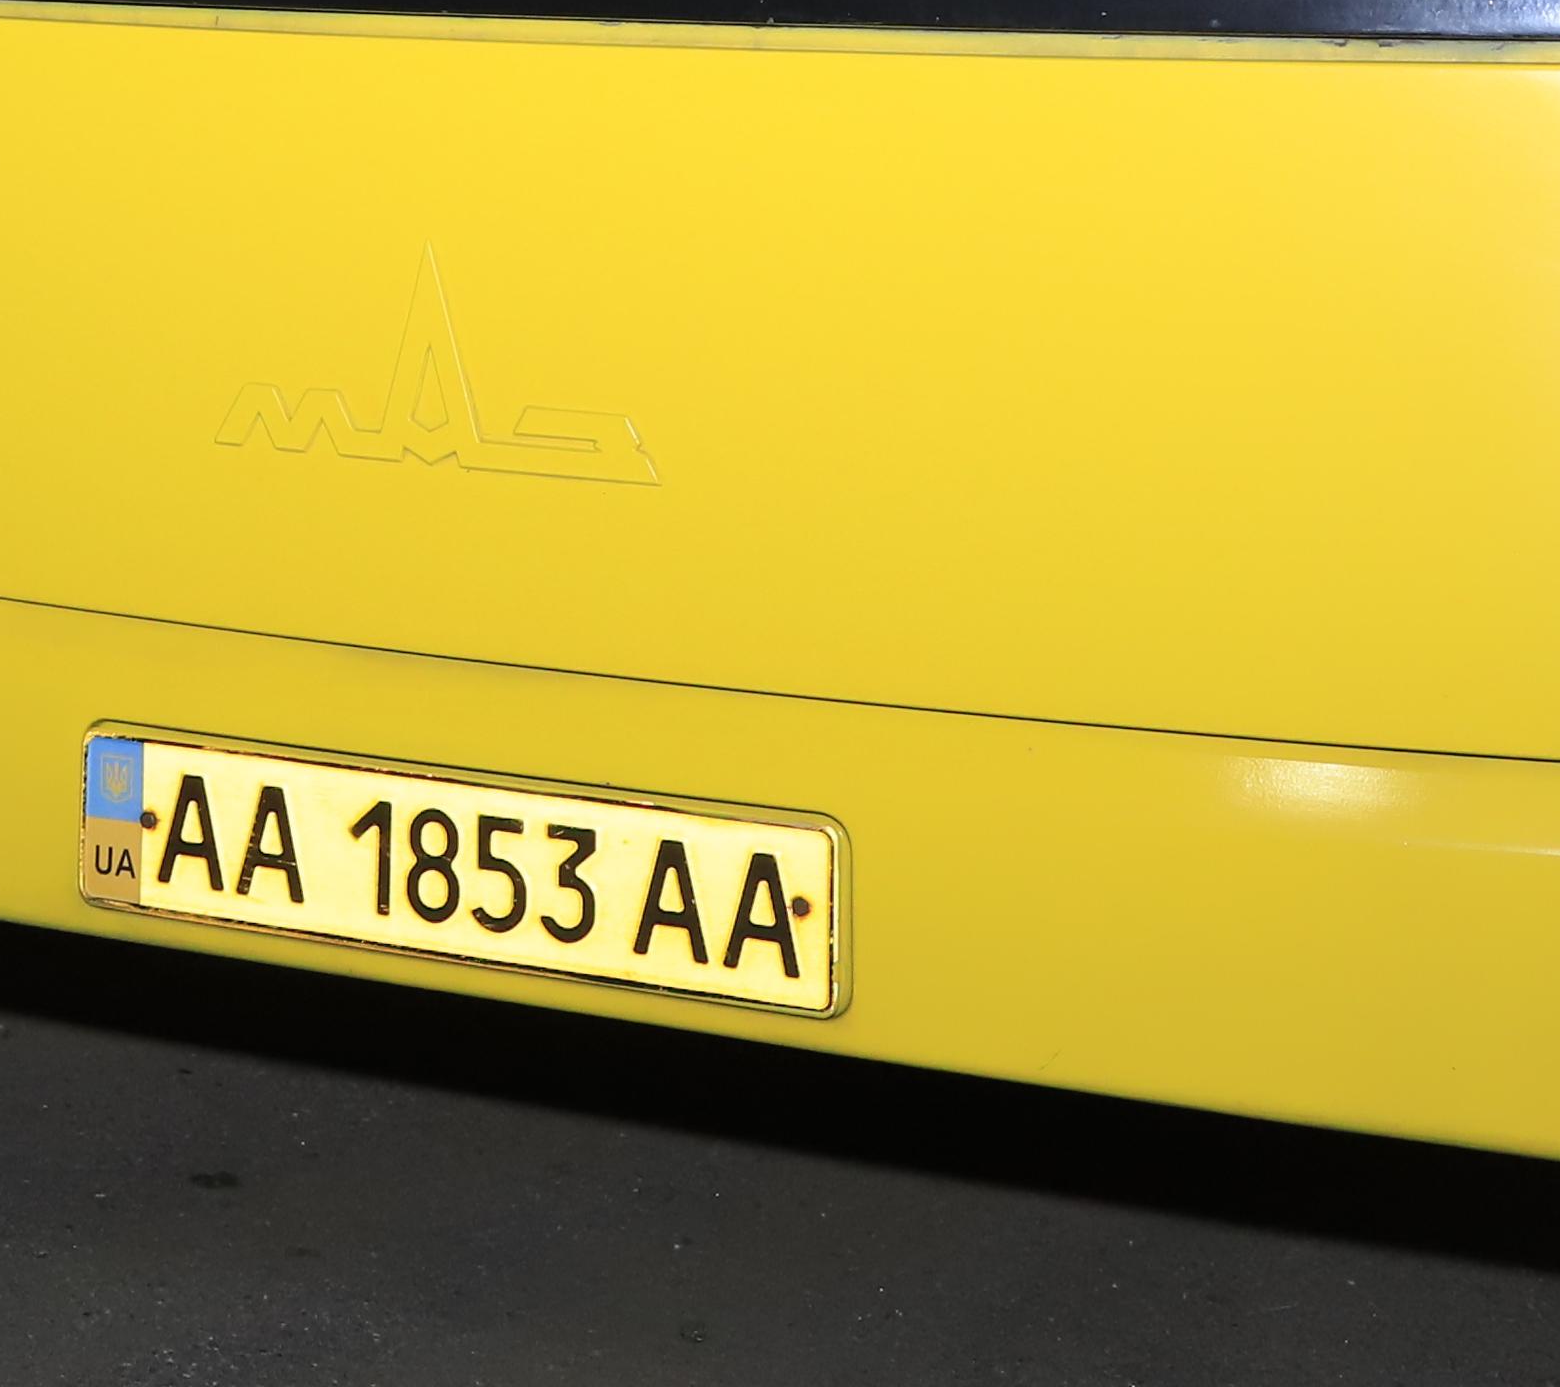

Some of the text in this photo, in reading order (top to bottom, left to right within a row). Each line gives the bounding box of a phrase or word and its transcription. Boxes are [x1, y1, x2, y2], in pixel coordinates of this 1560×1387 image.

[93, 843, 137, 880] UA
[157, 774, 801, 979] AA 1853 AA
